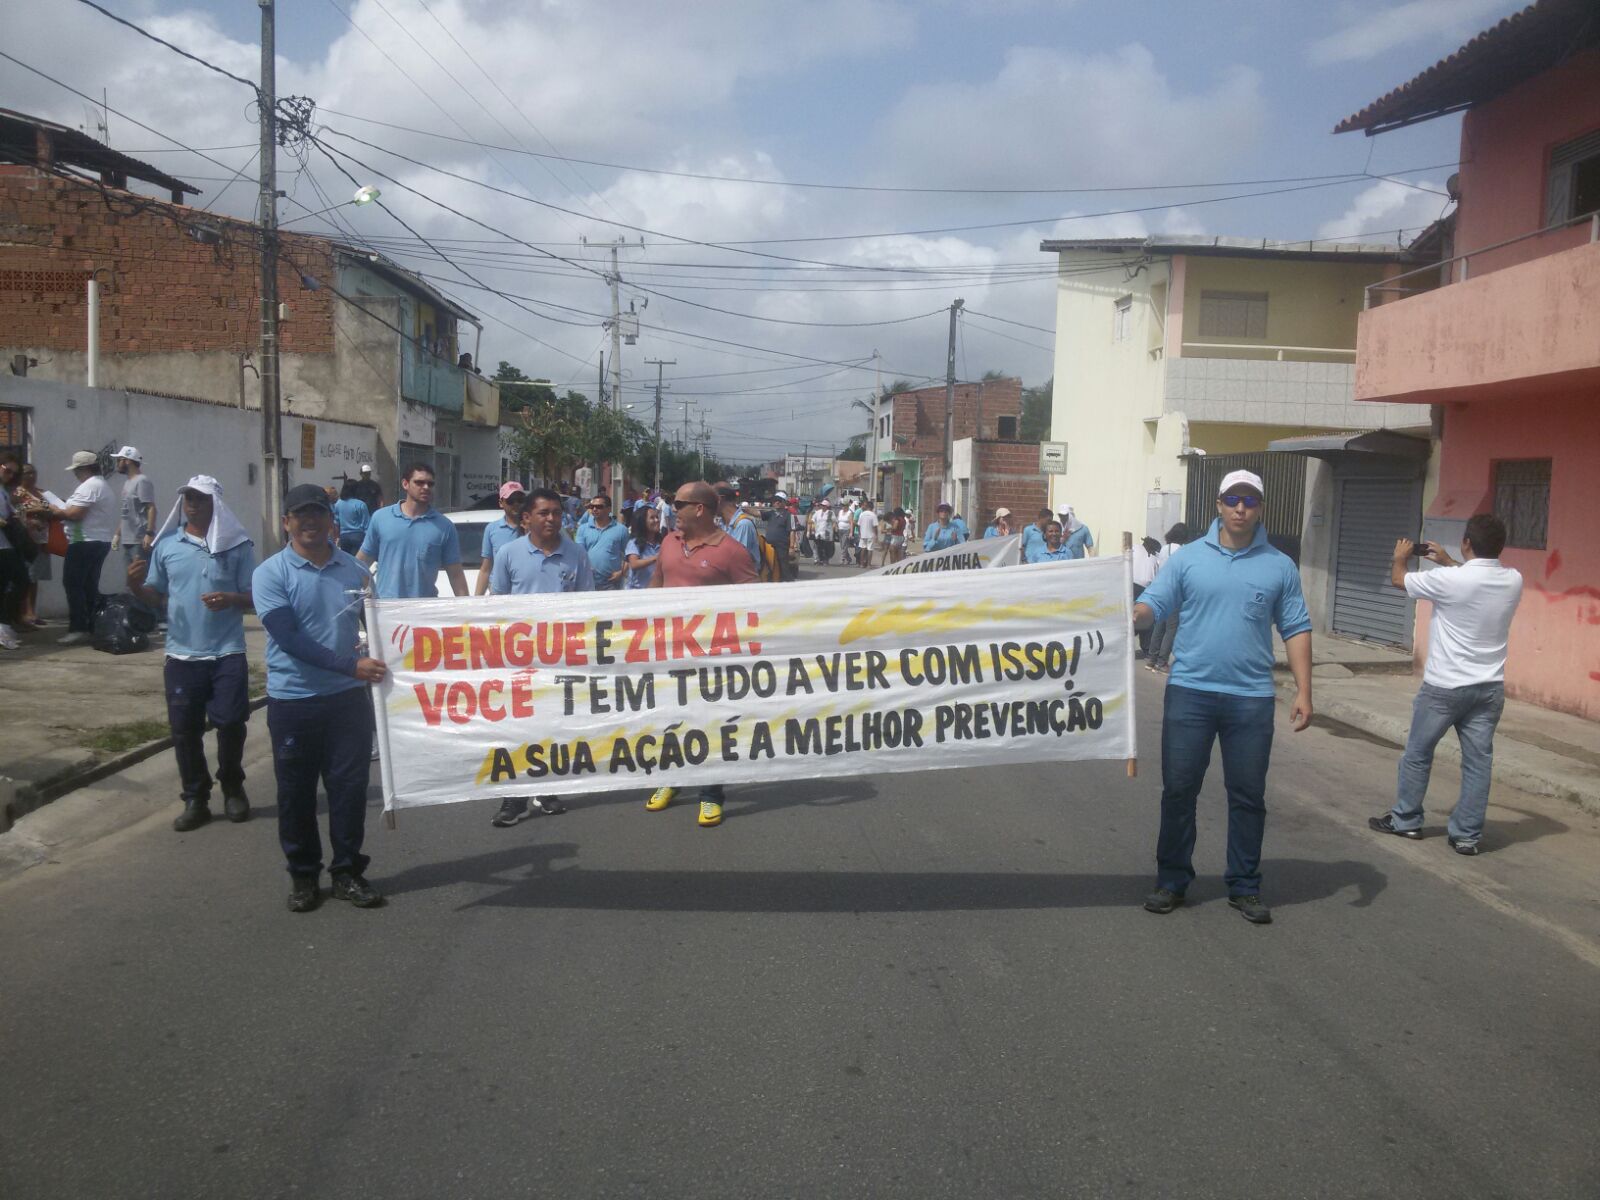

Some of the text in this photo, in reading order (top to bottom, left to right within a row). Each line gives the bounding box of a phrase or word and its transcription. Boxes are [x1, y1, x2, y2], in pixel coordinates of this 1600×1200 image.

[903, 552, 982, 575] CAMPANHA
[596, 620, 615, 665] E
[413, 667, 536, 726] VOCÊ
[554, 672, 656, 716] TEM
[668, 660, 777, 706] TUDO
[785, 657, 814, 696] A
[815, 649, 891, 691] VER
[900, 645, 983, 687] COM
[490, 691, 1104, 782] A SUA AÇÃO É A MELHOR PREVENÇÃO
